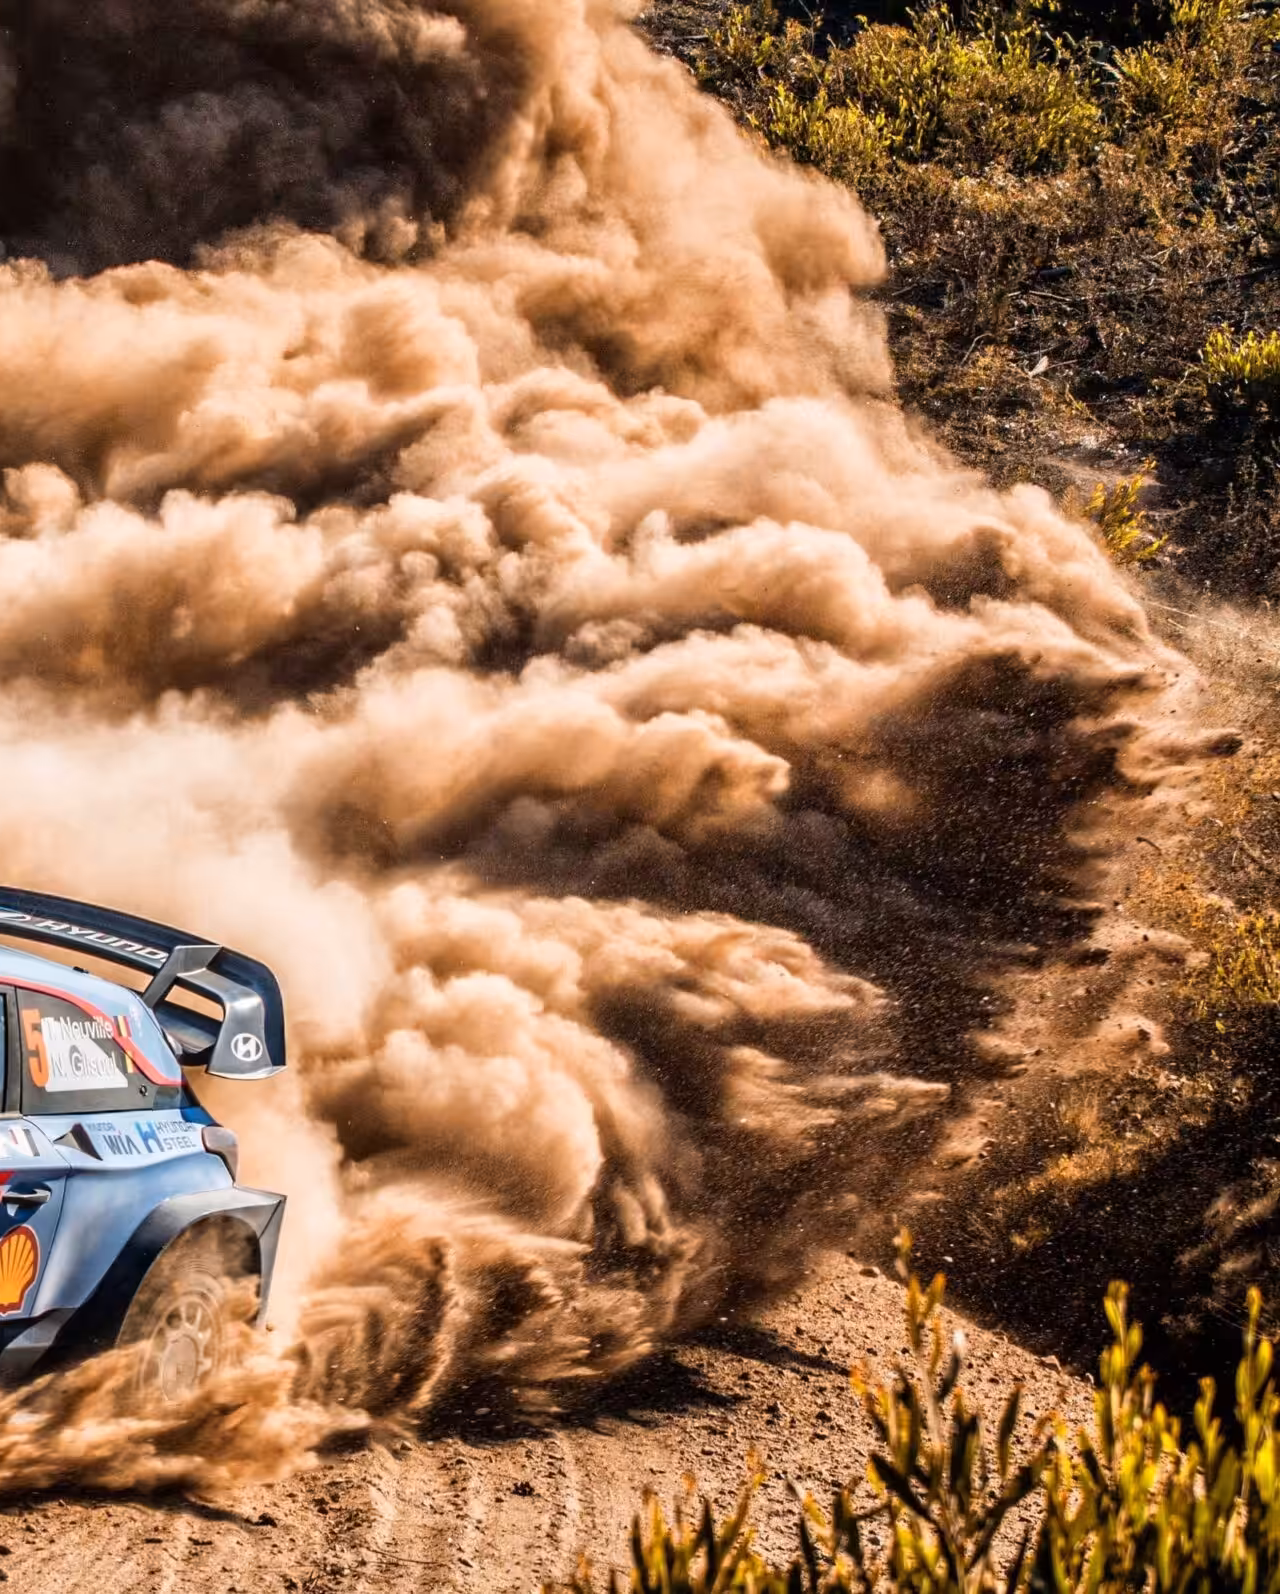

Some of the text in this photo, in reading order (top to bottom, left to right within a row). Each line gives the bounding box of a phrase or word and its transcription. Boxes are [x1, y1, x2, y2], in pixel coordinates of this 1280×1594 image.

[32, 919, 170, 963] HYUND
[59, 1015, 114, 1041] Neuville
[21, 1008, 50, 1088] 5
[101, 1132, 141, 1155] WIA
[163, 1136, 197, 1150] STEEL
